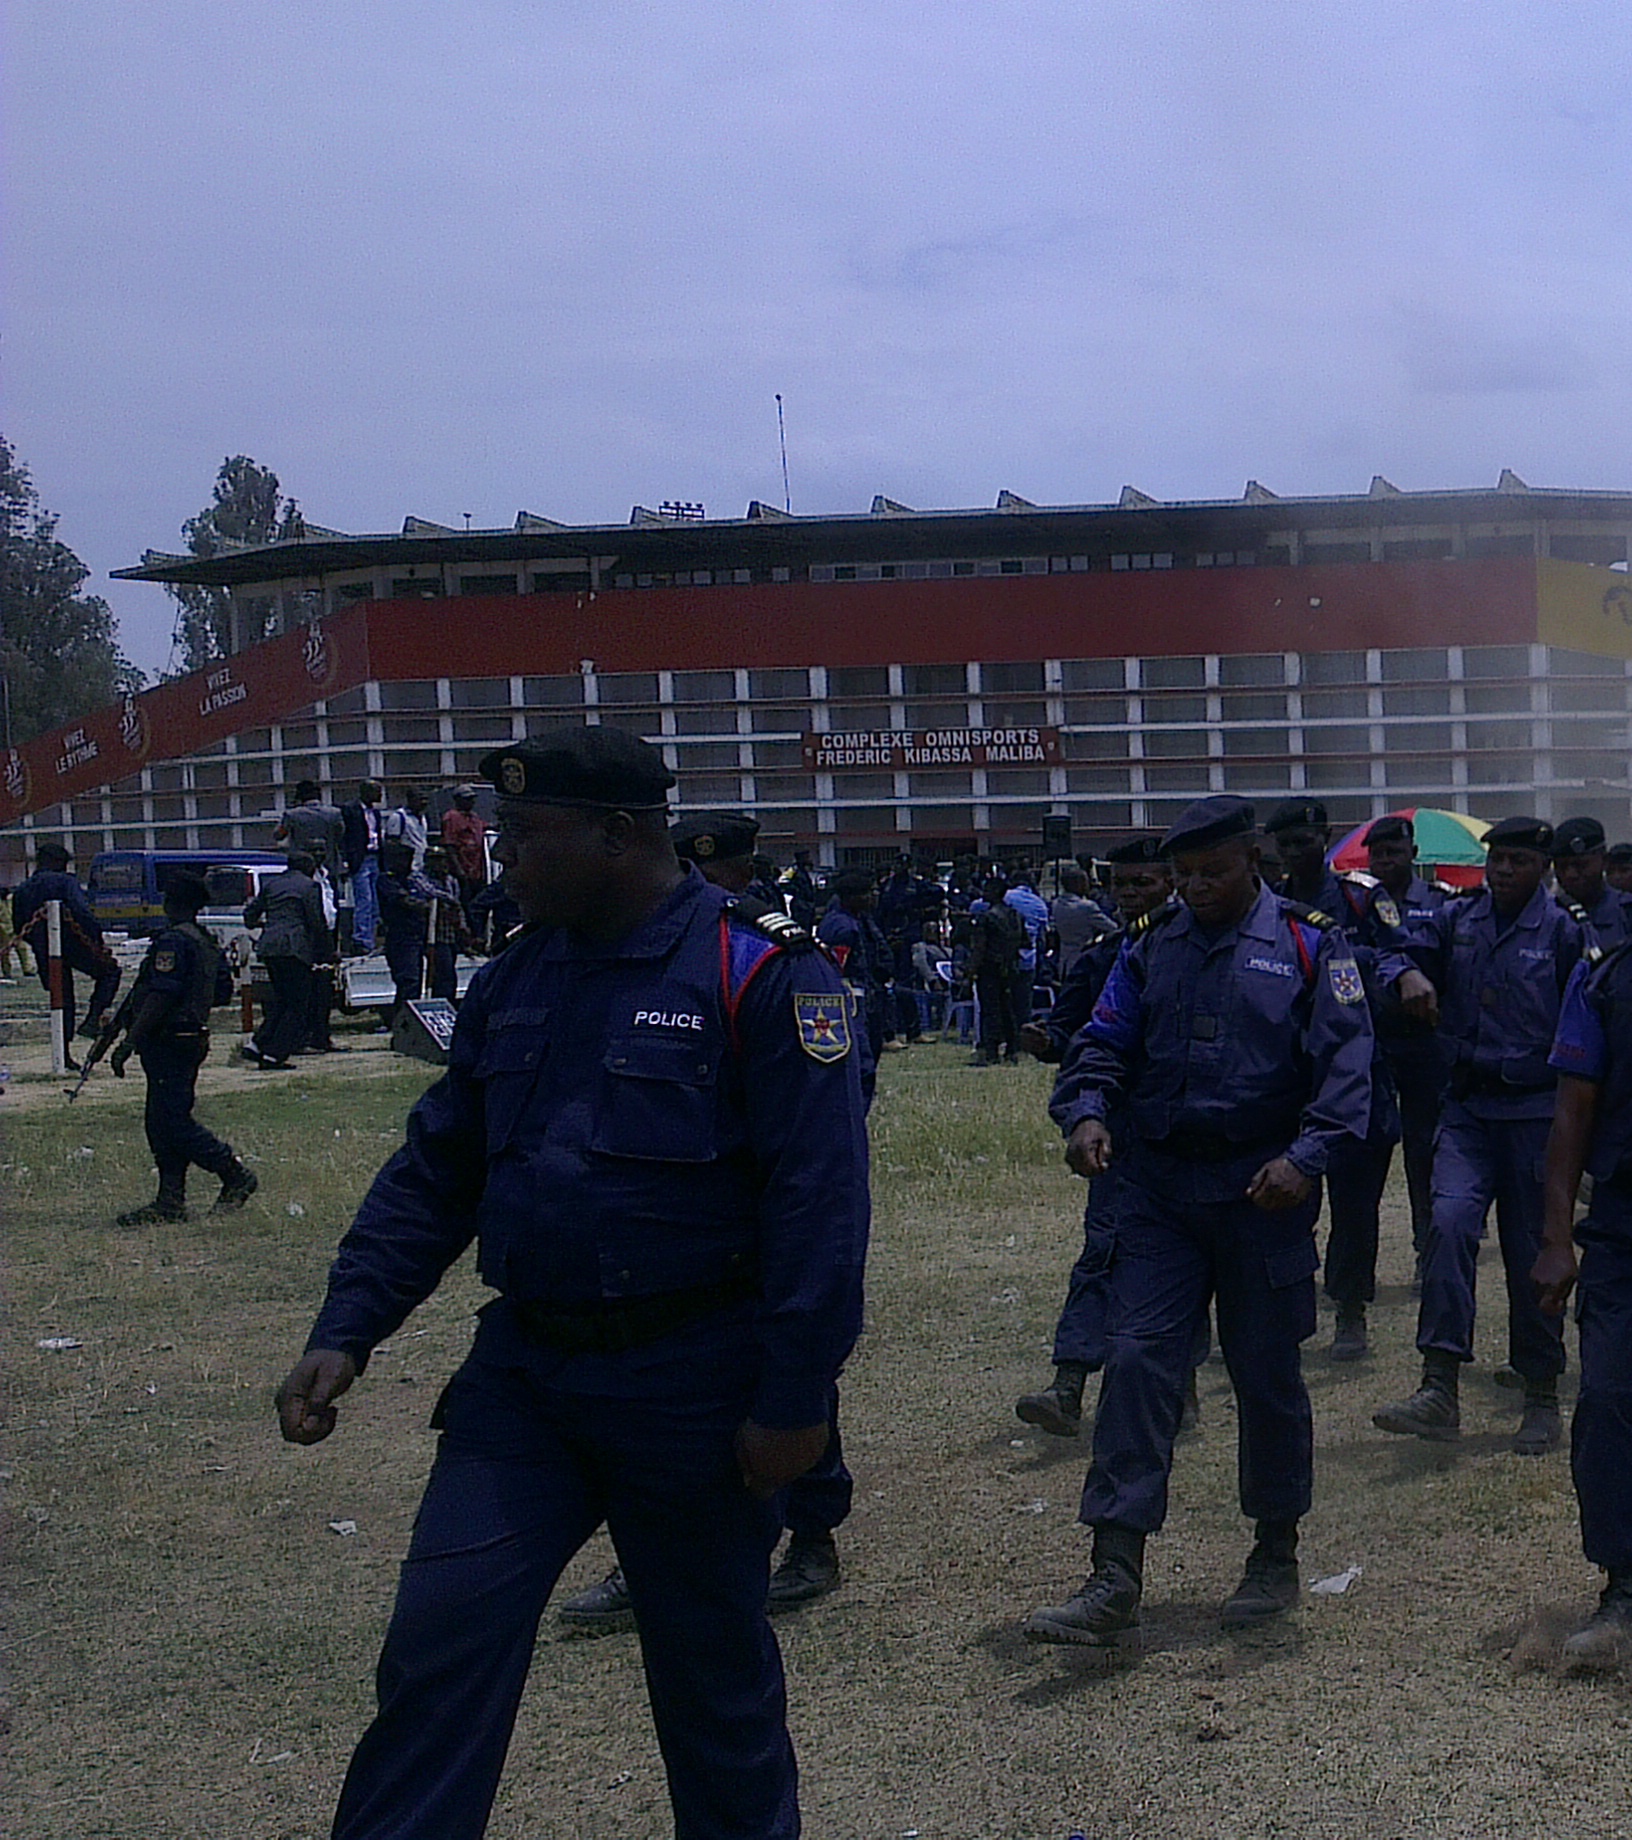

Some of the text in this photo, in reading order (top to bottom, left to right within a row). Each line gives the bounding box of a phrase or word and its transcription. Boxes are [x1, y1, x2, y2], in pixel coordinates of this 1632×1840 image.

[199, 697, 212, 716] LA
[821, 729, 1040, 750] COMPLEXE OMNISPORTS
[55, 756, 68, 774] LE
[815, 745, 1046, 766] FREDERIC KIBASSA MALIBA
[1249, 958, 1293, 977] POLICE
[798, 996, 841, 1007] POLICE
[633, 1011, 705, 1031] POLICE
